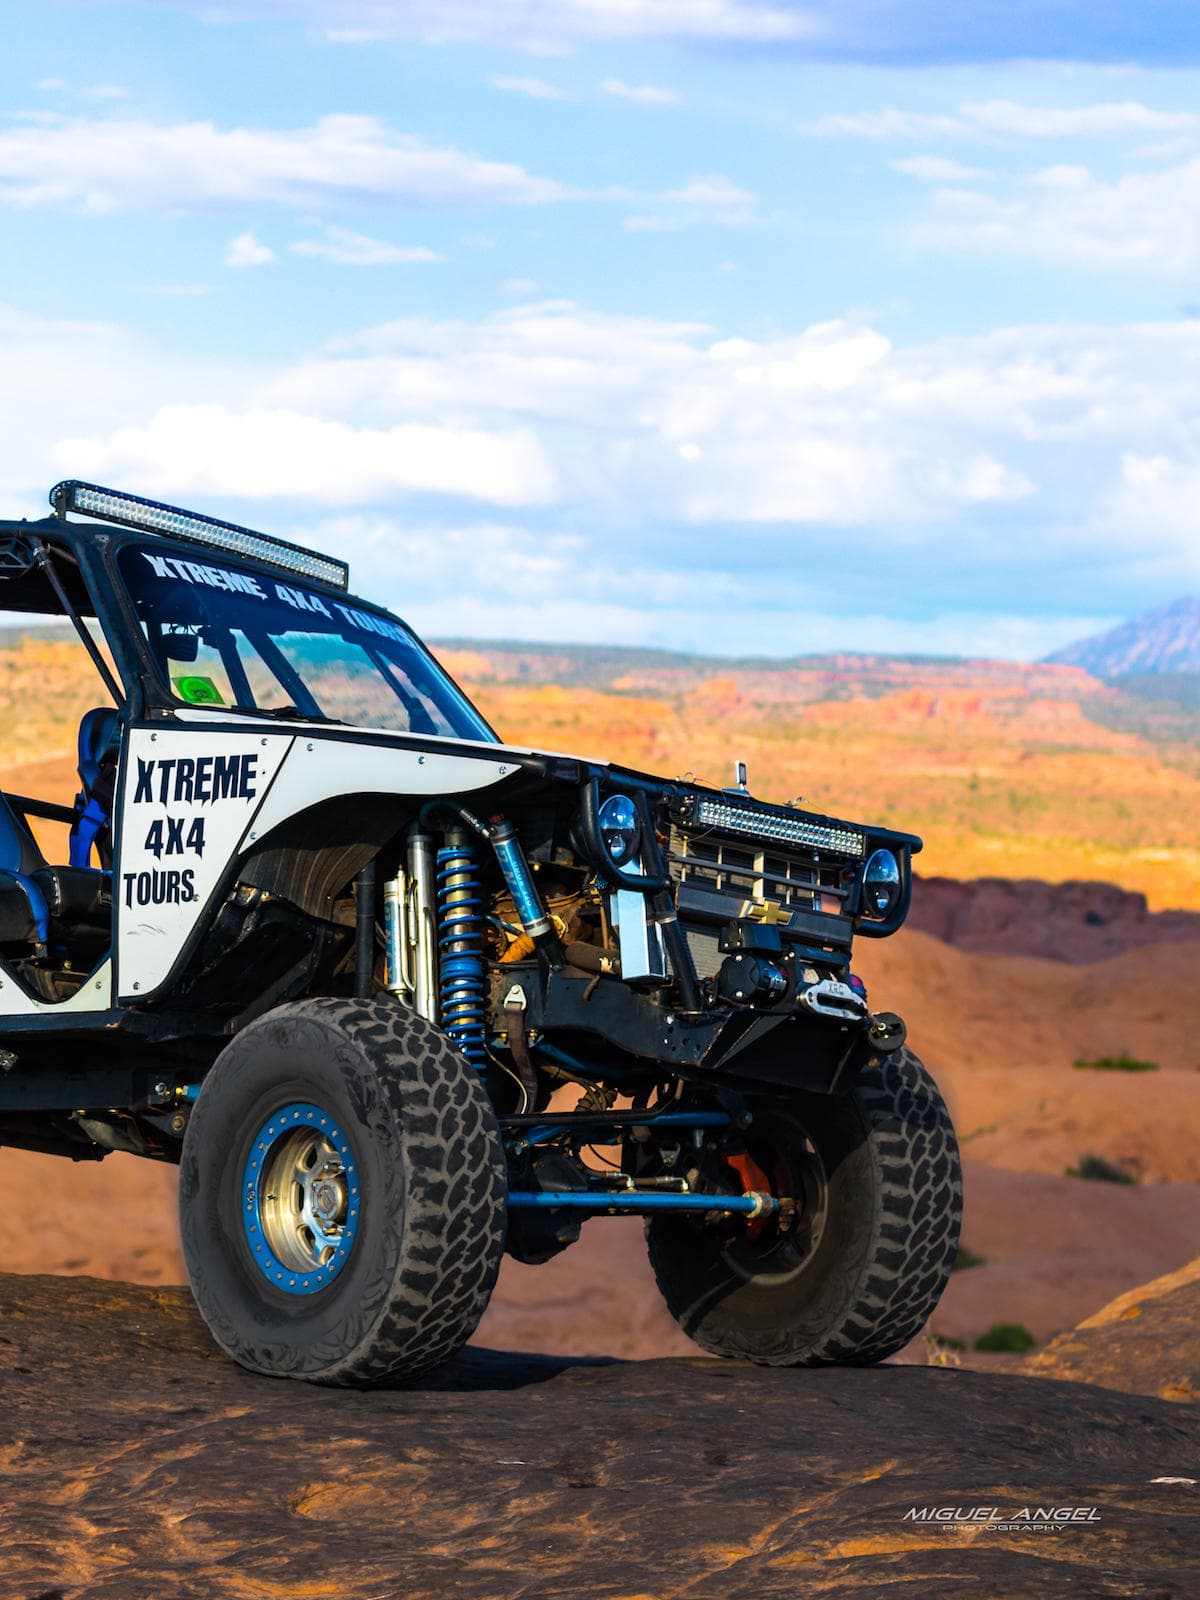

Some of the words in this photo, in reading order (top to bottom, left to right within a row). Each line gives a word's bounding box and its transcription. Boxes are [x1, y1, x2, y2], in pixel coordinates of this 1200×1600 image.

[140, 552, 268, 600] XTREME
[274, 583, 334, 621] 4X4
[133, 754, 258, 808] XTREME
[144, 815, 206, 862] 4X4
